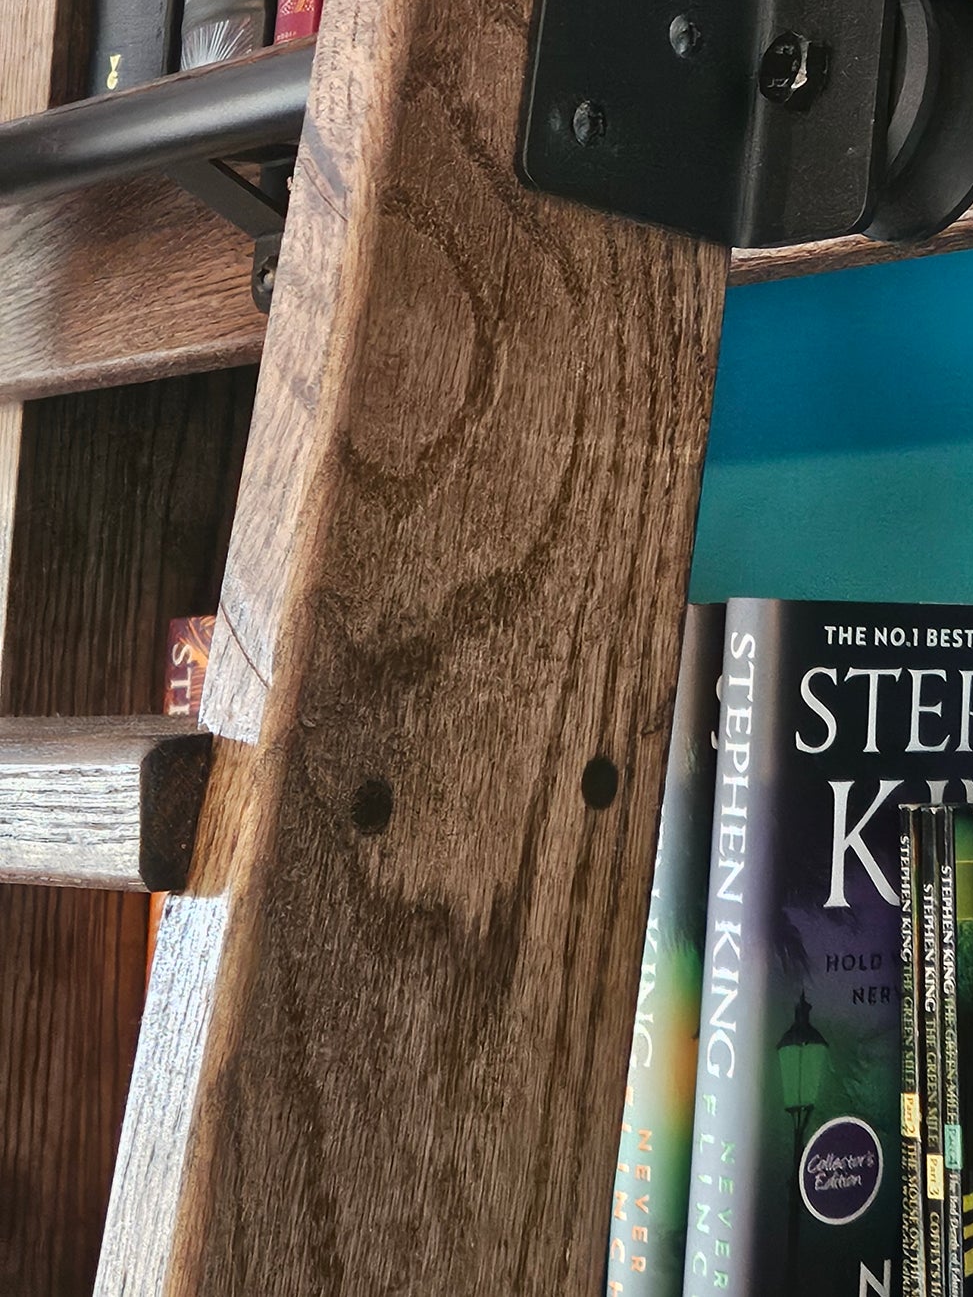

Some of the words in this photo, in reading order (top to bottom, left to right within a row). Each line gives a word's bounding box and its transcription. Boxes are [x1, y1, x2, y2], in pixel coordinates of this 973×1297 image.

[823, 625, 867, 646] THE
[873, 627, 919, 648] NO.1
[714, 631, 756, 904] STEPHEN
[900, 834, 913, 913] STEPHEN
[941, 865, 955, 948] STEPHEN
[900, 914, 914, 964] KING
[922, 883, 936, 963] STEPHEN
[705, 919, 743, 1080] KING
[824, 954, 883, 973] HOLD
[923, 965, 937, 1014] KING
[942, 948, 957, 995] KING
[630, 1128, 653, 1274] NEVER
[712, 1140, 738, 1290] NEVER
[814, 1170, 863, 1192] Edition
